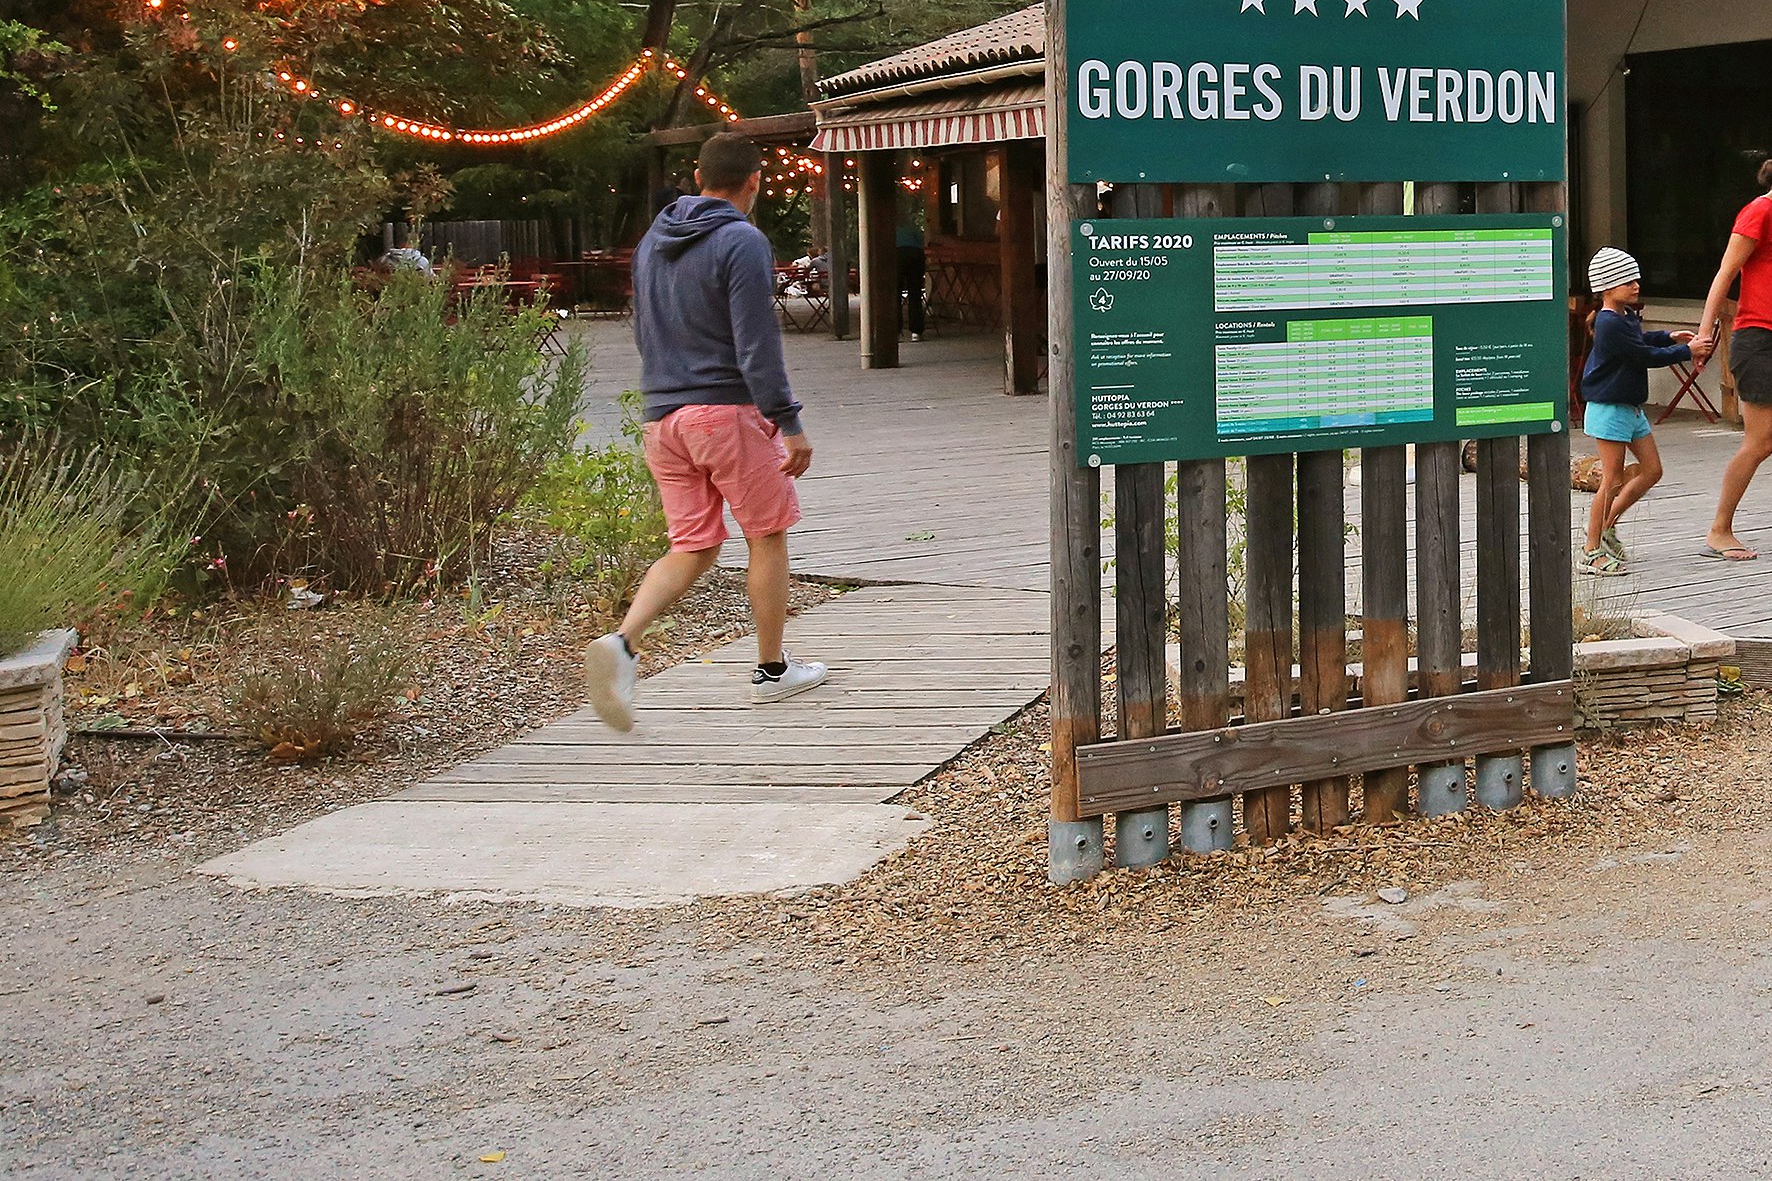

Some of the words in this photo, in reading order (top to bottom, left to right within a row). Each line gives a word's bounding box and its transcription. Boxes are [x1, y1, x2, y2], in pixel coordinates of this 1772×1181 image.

[1077, 58, 1283, 120] GORGES
[1299, 64, 1361, 122] DU
[1377, 66, 1556, 124] VERDON
[1088, 235, 1150, 250] TARIFS
[1152, 234, 1193, 249] 2020
[1089, 256, 1124, 267] Ouvert
[1126, 256, 1137, 266] du
[1140, 256, 1168, 266] 15/05
[1089, 273, 1101, 281] au
[1103, 270, 1151, 281] 27/09/20
[1091, 394, 1130, 403] HUTTOPIA
[1091, 403, 1123, 411] GORGES
[1124, 402, 1136, 410] DU
[1136, 401, 1169, 409] VERDON
[1106, 411, 1116, 419] 04
[1117, 411, 1126, 419] 92
[1146, 410, 1155, 418] 64
[1091, 420, 1147, 429] www.huttopia.com
